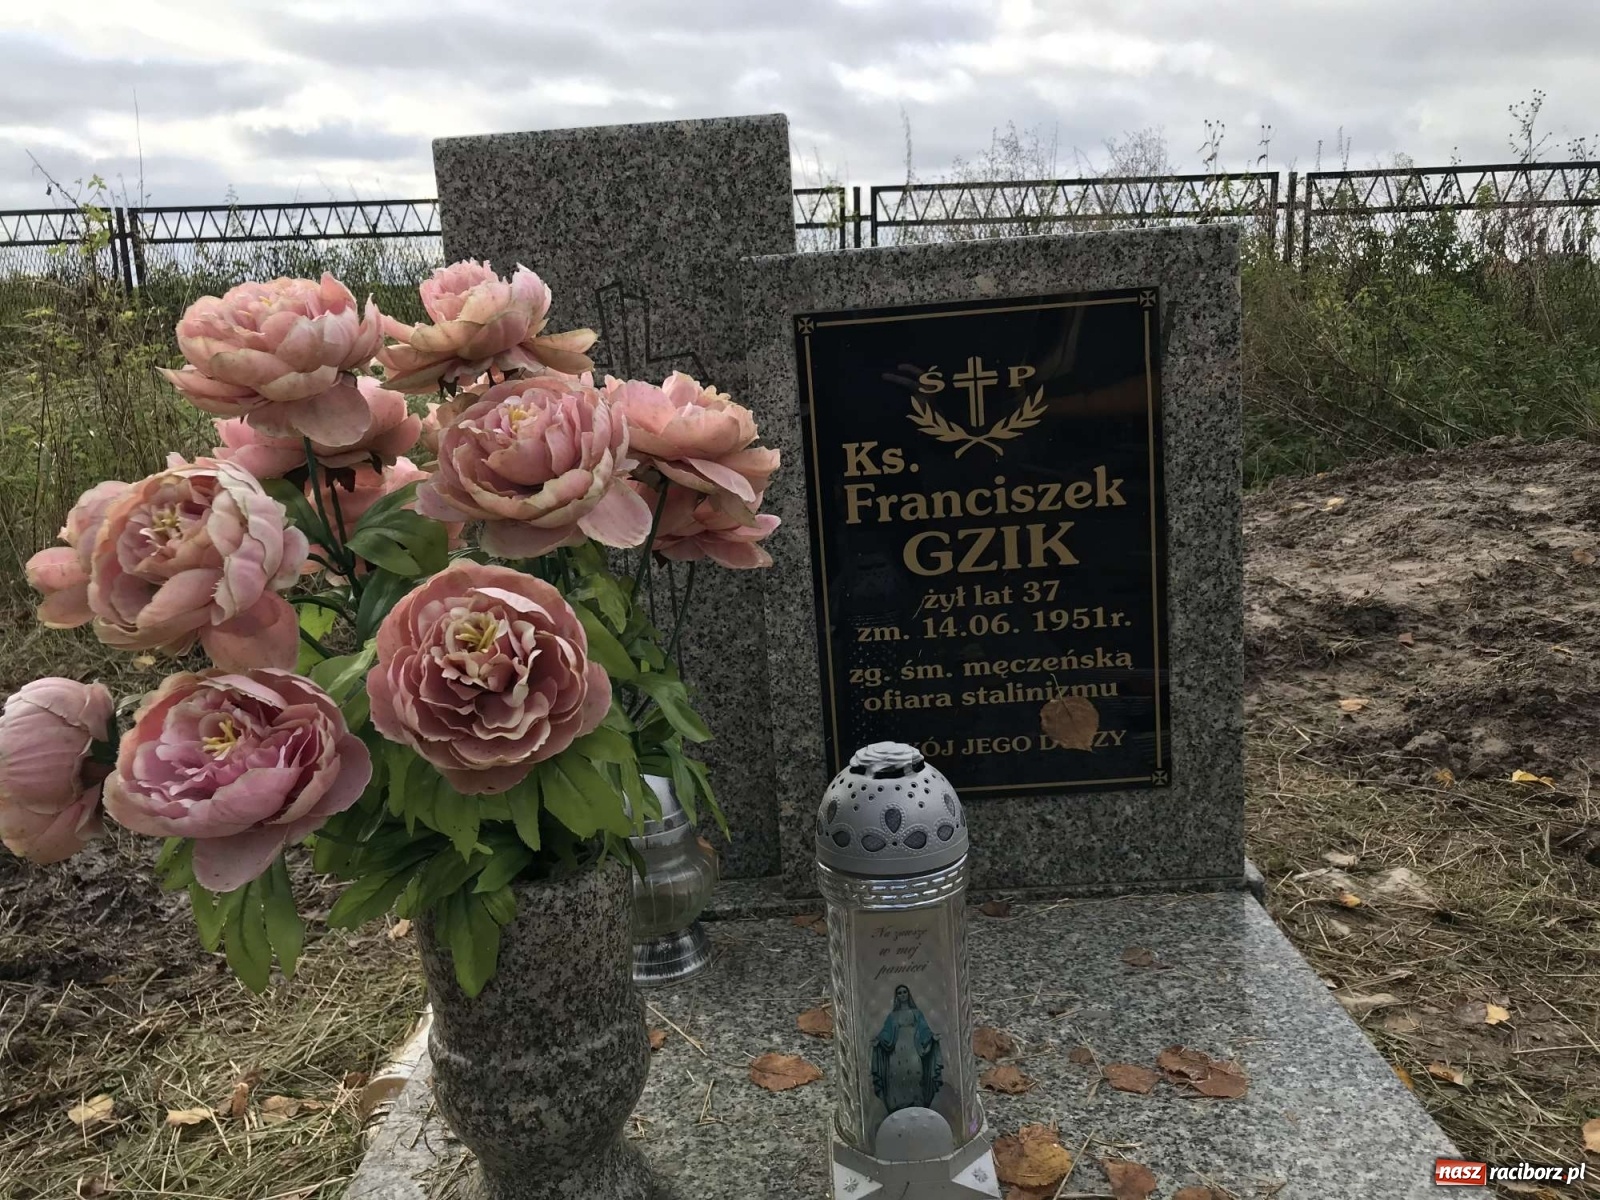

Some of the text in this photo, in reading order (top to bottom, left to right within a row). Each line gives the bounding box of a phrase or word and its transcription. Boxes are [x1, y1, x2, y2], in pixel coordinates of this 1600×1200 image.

[918, 365, 1036, 394] Ś P
[842, 441, 919, 477] Ks.
[844, 465, 1126, 524] Franciszek
[904, 521, 1079, 575] GZIK
[924, 580, 1060, 613] żył lat 37
[858, 606, 1131, 642] zm. 14.06. 1951r.
[849, 647, 1133, 687] zg. śm. męczeńską
[864, 681, 1118, 711] ofiara stalinizmu
[961, 735, 1031, 755] JEGO
[1039, 729, 1127, 751] DZY
